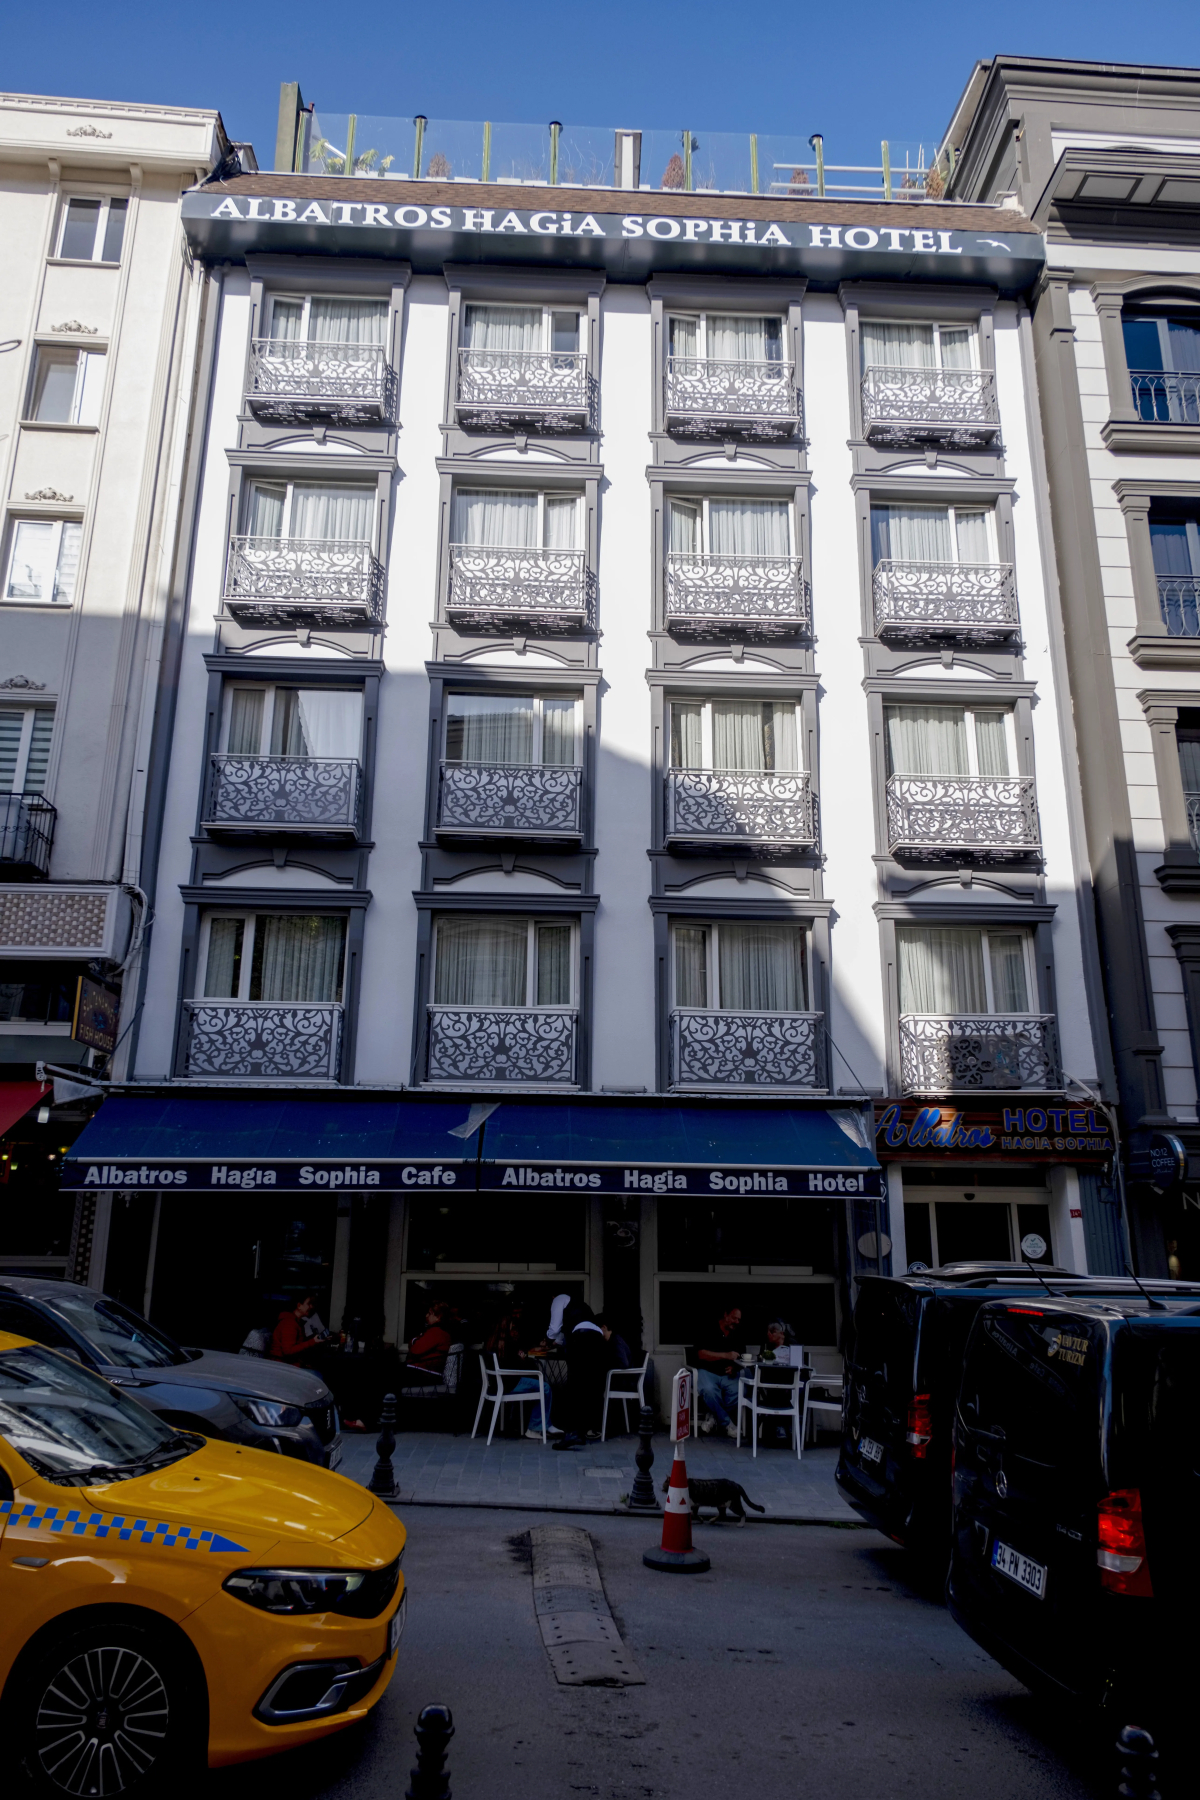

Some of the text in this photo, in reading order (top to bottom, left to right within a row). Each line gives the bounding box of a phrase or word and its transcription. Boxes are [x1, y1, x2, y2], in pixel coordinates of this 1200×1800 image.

[210, 196, 452, 230] ALBATROS
[809, 224, 962, 254] HOTEL
[79, 1022, 114, 1051] FISH HOUSE
[875, 1103, 996, 1149] Albatros
[1002, 1107, 1109, 1134] HOTEL
[1001, 1135, 1115, 1151] HAGIA SOPHIA
[1151, 1157, 1176, 1167] COFFEE
[84, 1165, 188, 1185] Albatros
[298, 1165, 380, 1189] Sophia
[401, 1165, 457, 1185] Cafe
[501, 1166, 865, 1195] Albatros Hagia Sophia Hotel
[996, 1544, 1042, 1591] 34 PN 3303
